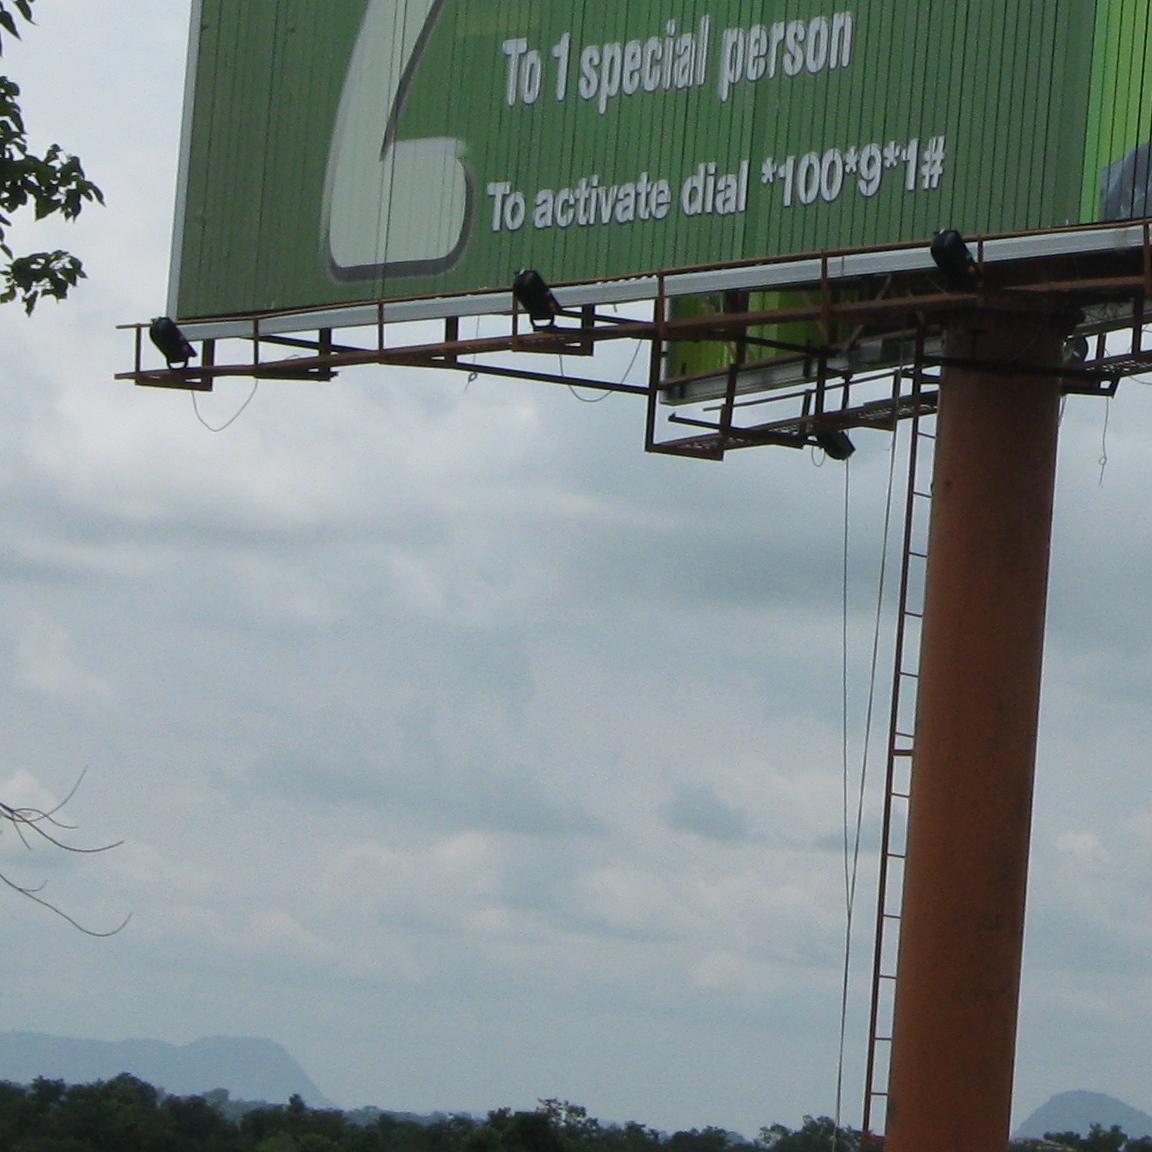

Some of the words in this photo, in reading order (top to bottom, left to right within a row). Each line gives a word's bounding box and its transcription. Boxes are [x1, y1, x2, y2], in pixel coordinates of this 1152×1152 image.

[503, 38, 541, 107] To
[552, 33, 572, 101] 1
[578, 14, 711, 114] special
[719, 10, 851, 102] person
[487, 181, 526, 232] To
[533, 170, 672, 230] activate
[682, 159, 748, 216] dial
